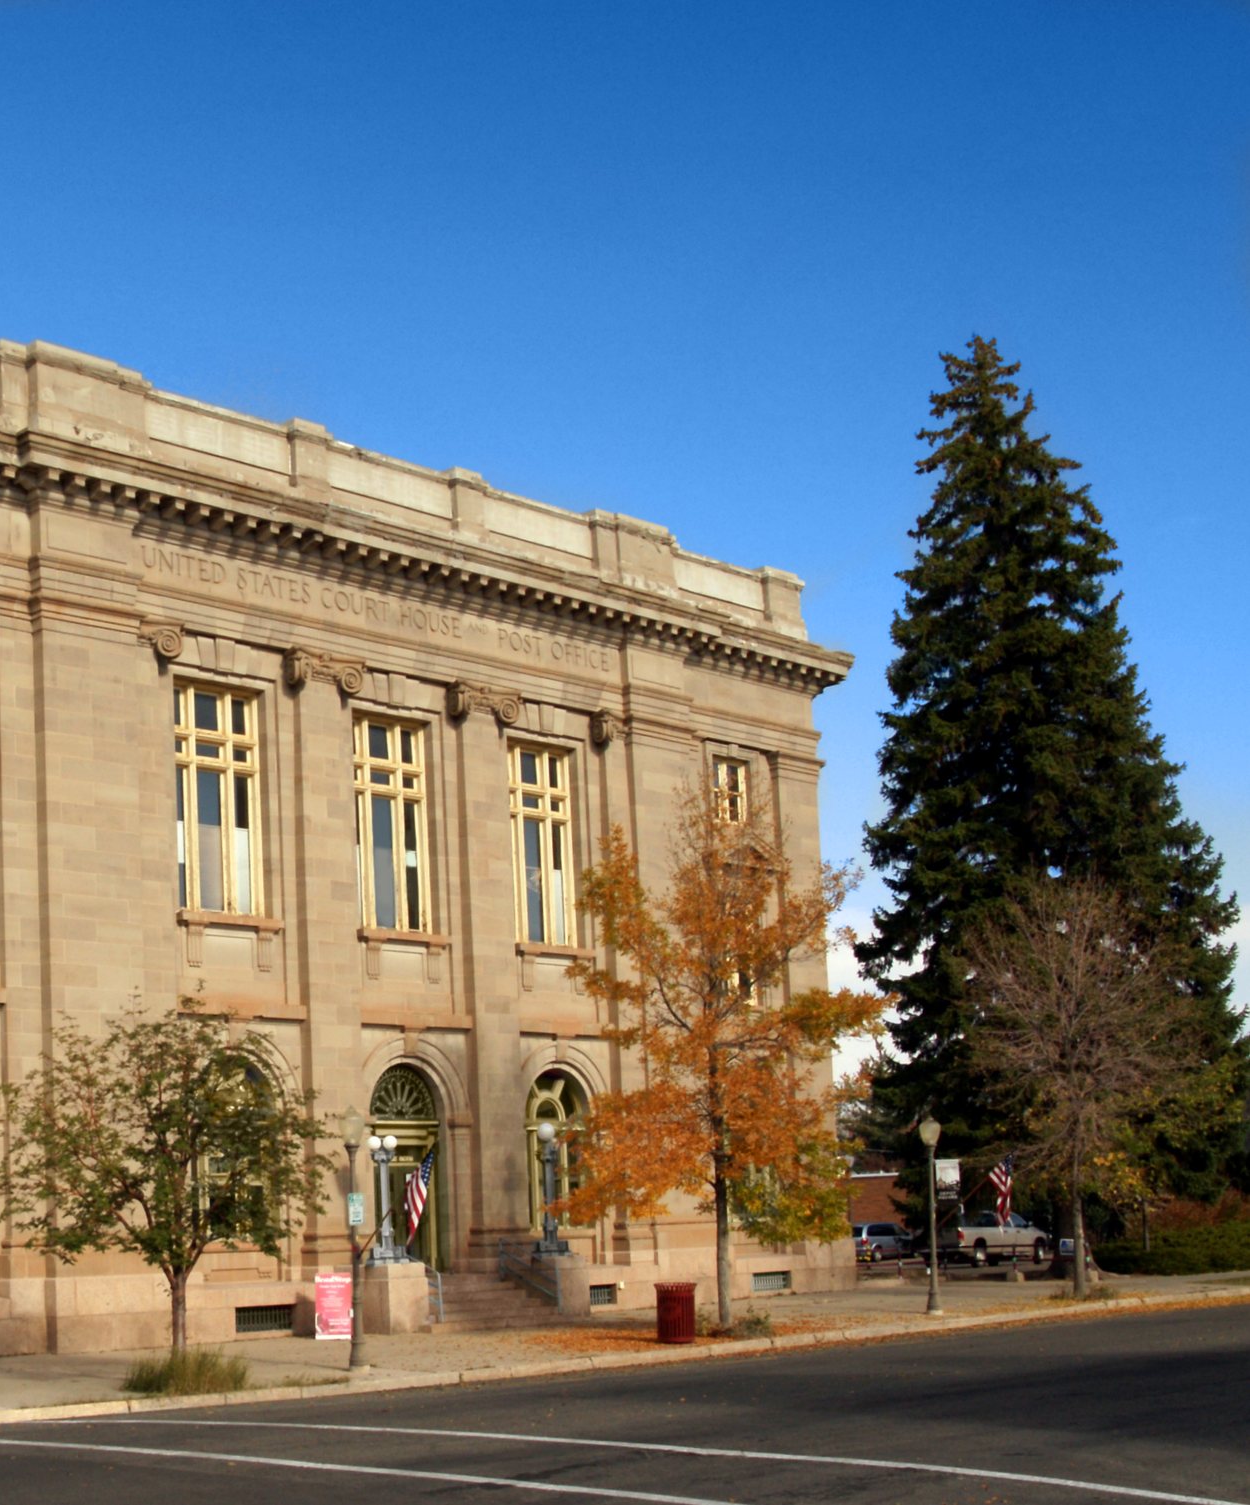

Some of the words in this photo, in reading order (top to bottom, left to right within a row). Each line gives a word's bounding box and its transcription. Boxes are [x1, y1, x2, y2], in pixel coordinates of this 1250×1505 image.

[141, 545, 227, 585] UNITED
[236, 567, 311, 604] STATES
[320, 586, 389, 622] COURT
[400, 606, 462, 640] HOUSE
[467, 620, 489, 636] AND
[497, 627, 542, 658] POST
[550, 640, 611, 673] OFFICE
